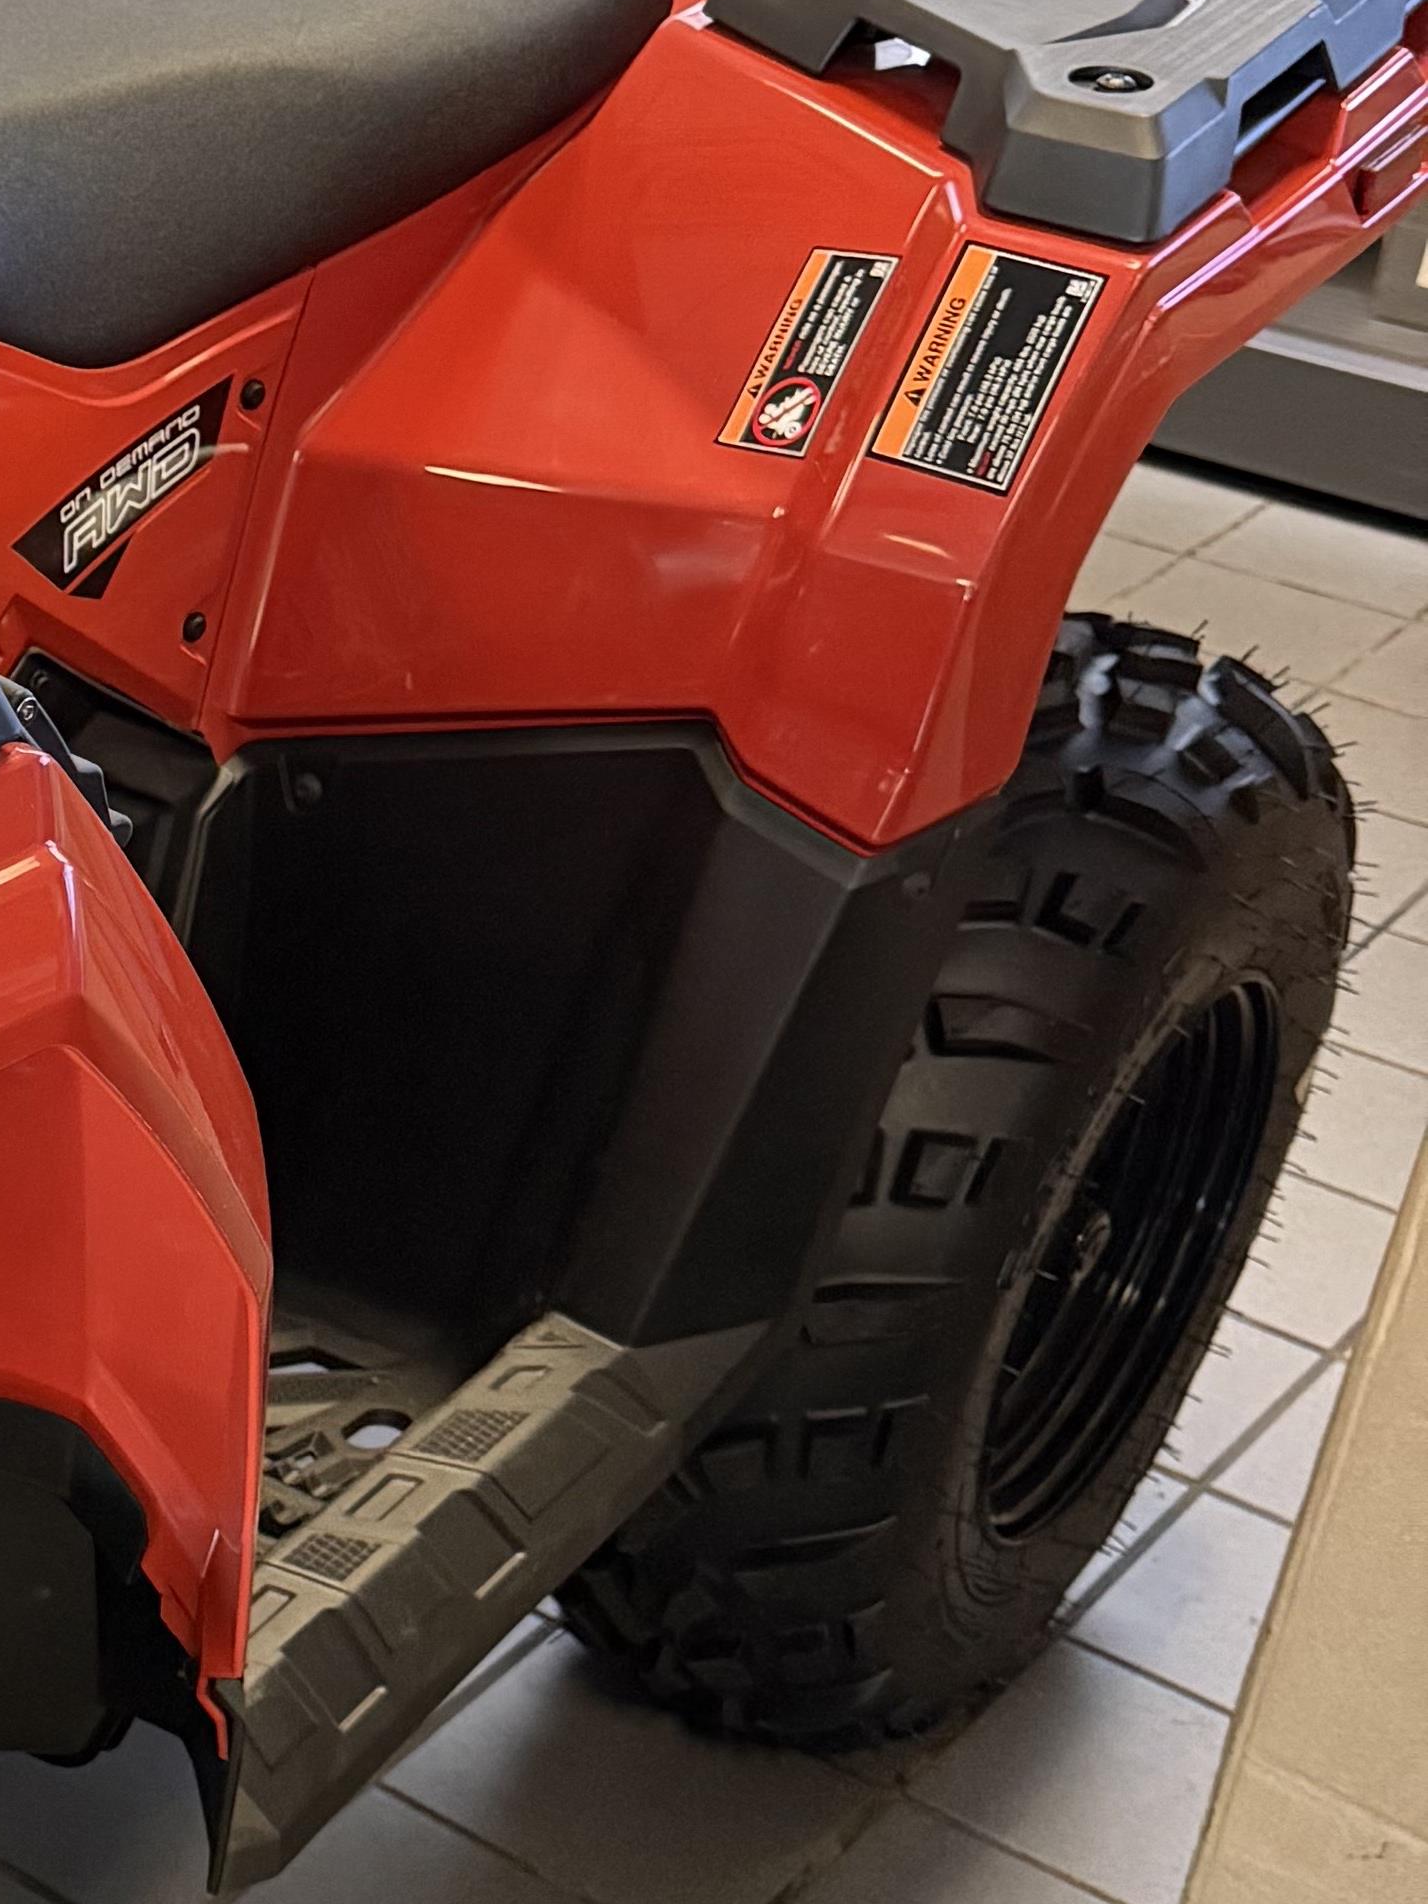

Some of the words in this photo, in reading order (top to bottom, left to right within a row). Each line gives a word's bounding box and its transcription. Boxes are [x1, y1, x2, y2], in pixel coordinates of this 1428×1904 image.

[753, 298, 804, 379] WARNING
[912, 295, 967, 384] WARNING
[60, 487, 91, 524] ON
[99, 404, 201, 490] DEMAND
[63, 427, 201, 574] AWD
